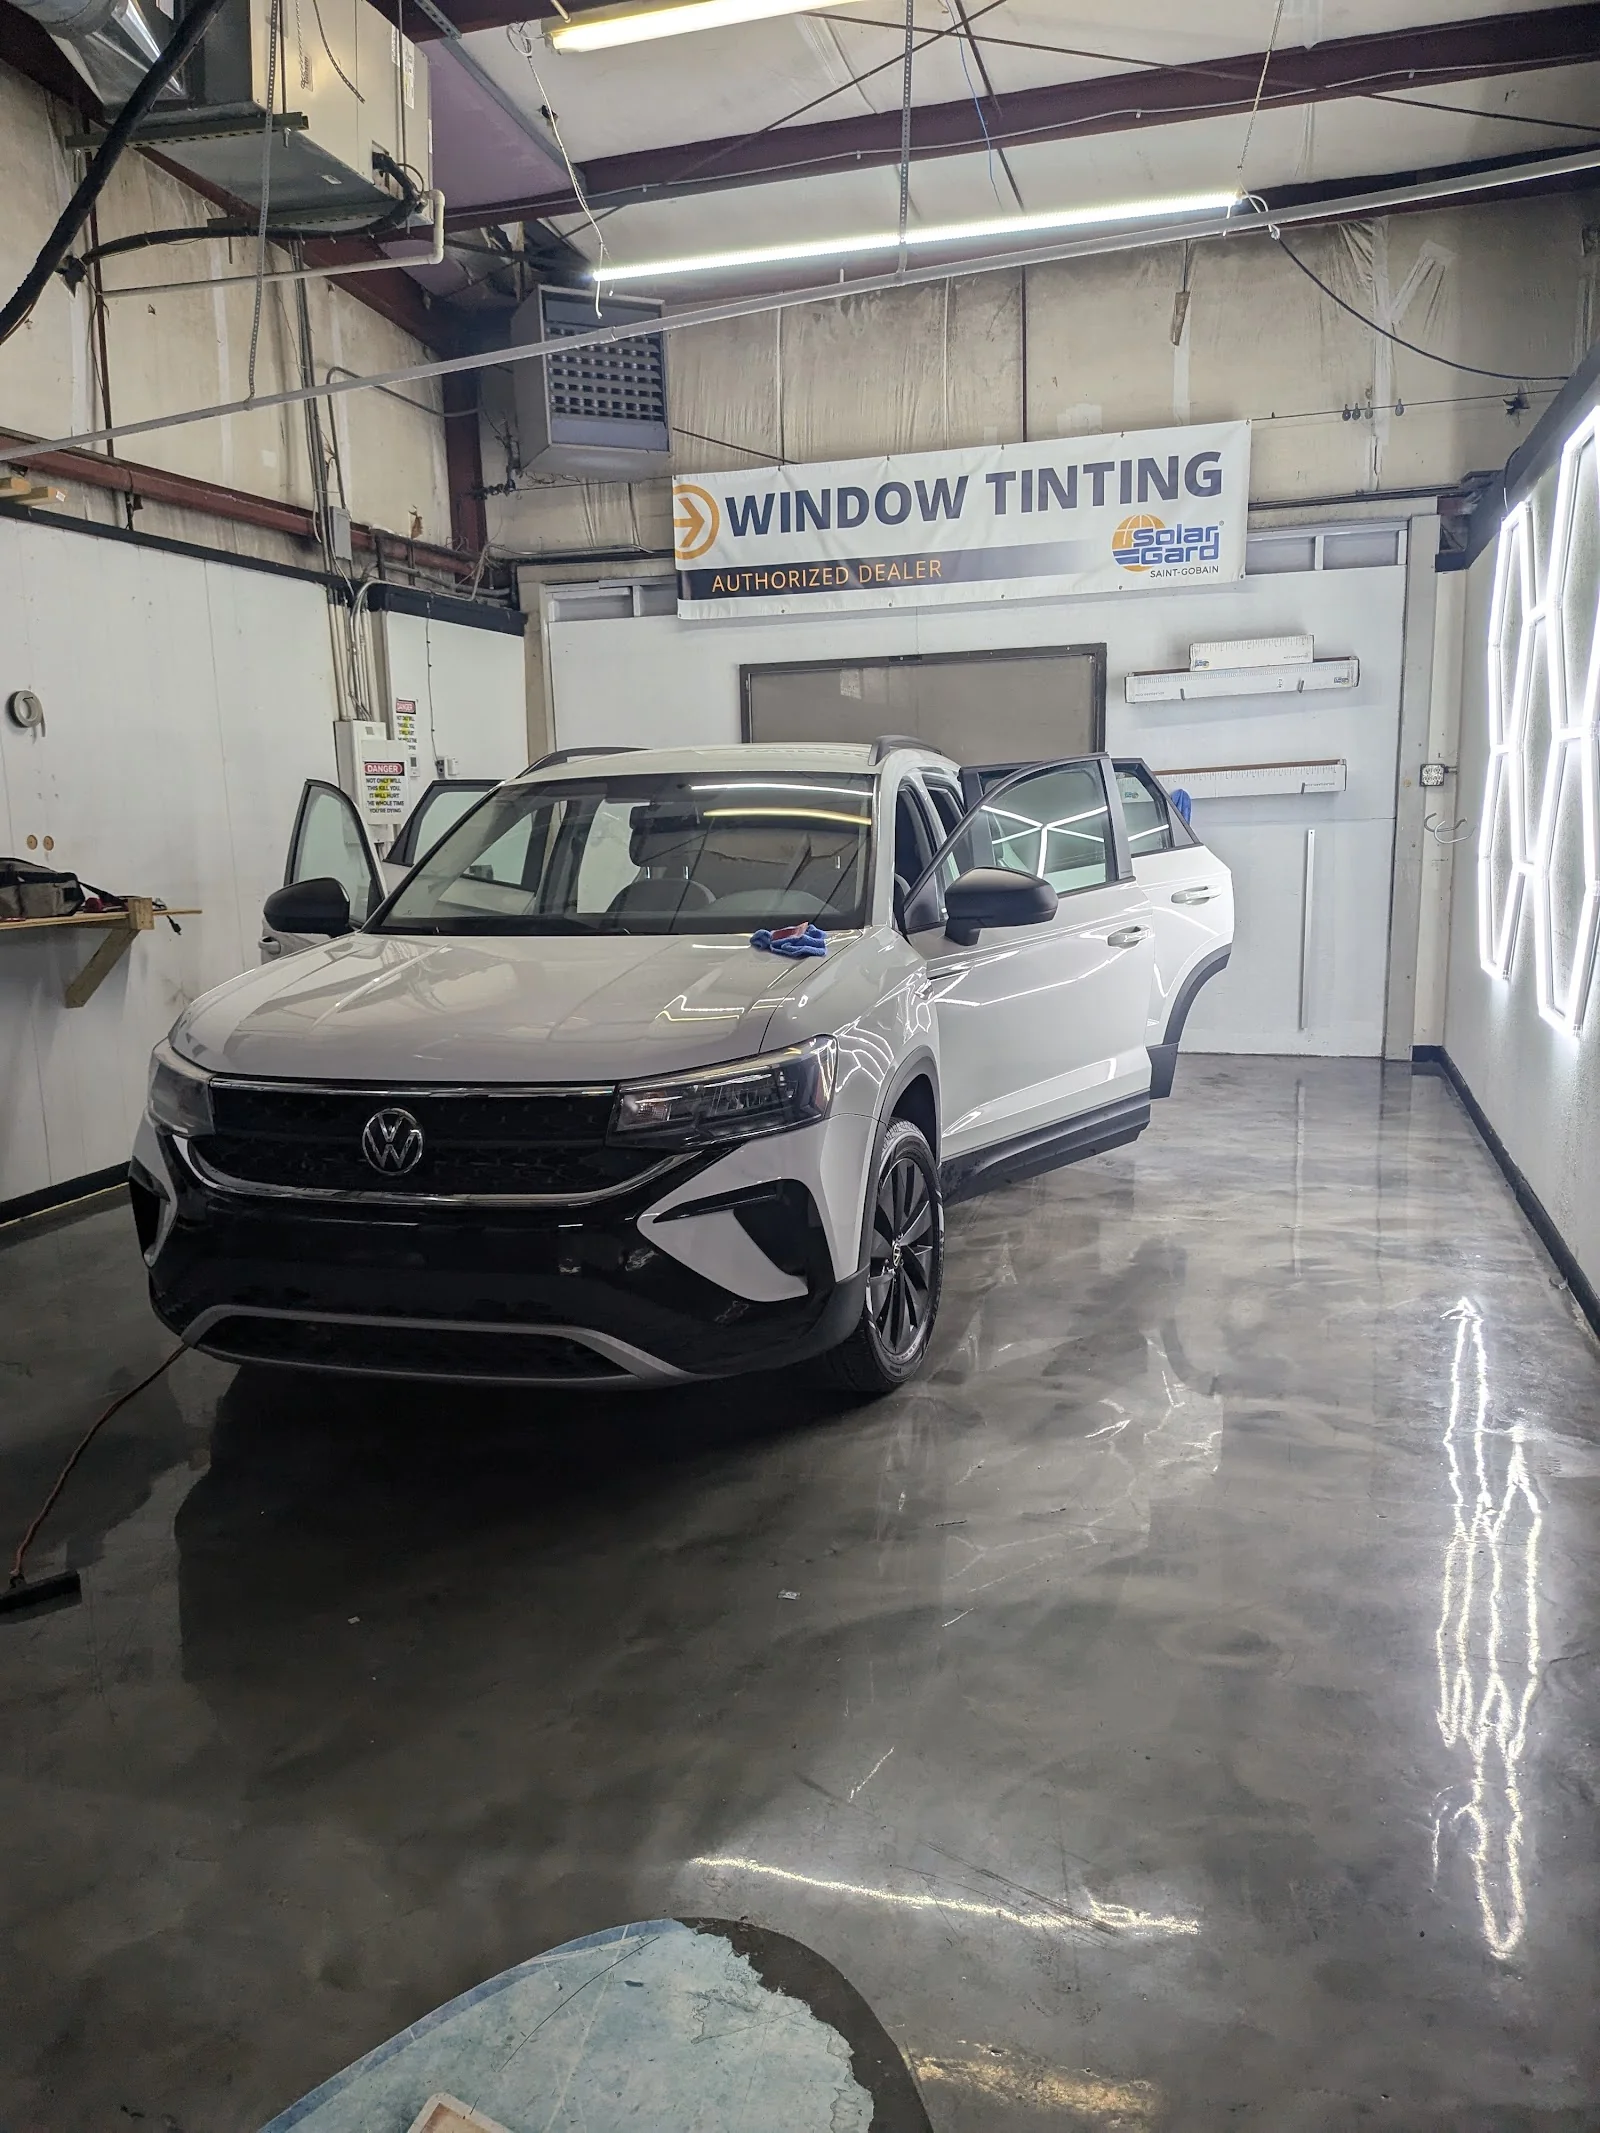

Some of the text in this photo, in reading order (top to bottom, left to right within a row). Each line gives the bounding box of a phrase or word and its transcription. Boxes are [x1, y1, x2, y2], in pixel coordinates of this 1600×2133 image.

[725, 451, 1222, 537] WINDOW TINTING
[1132, 523, 1219, 548] Solar
[1140, 532, 1220, 565] Gard
[711, 559, 942, 593] AUTHORIZED DEALER
[1149, 565, 1219, 578] SAINT-GOBAIN
[367, 764, 399, 773] DANGER
